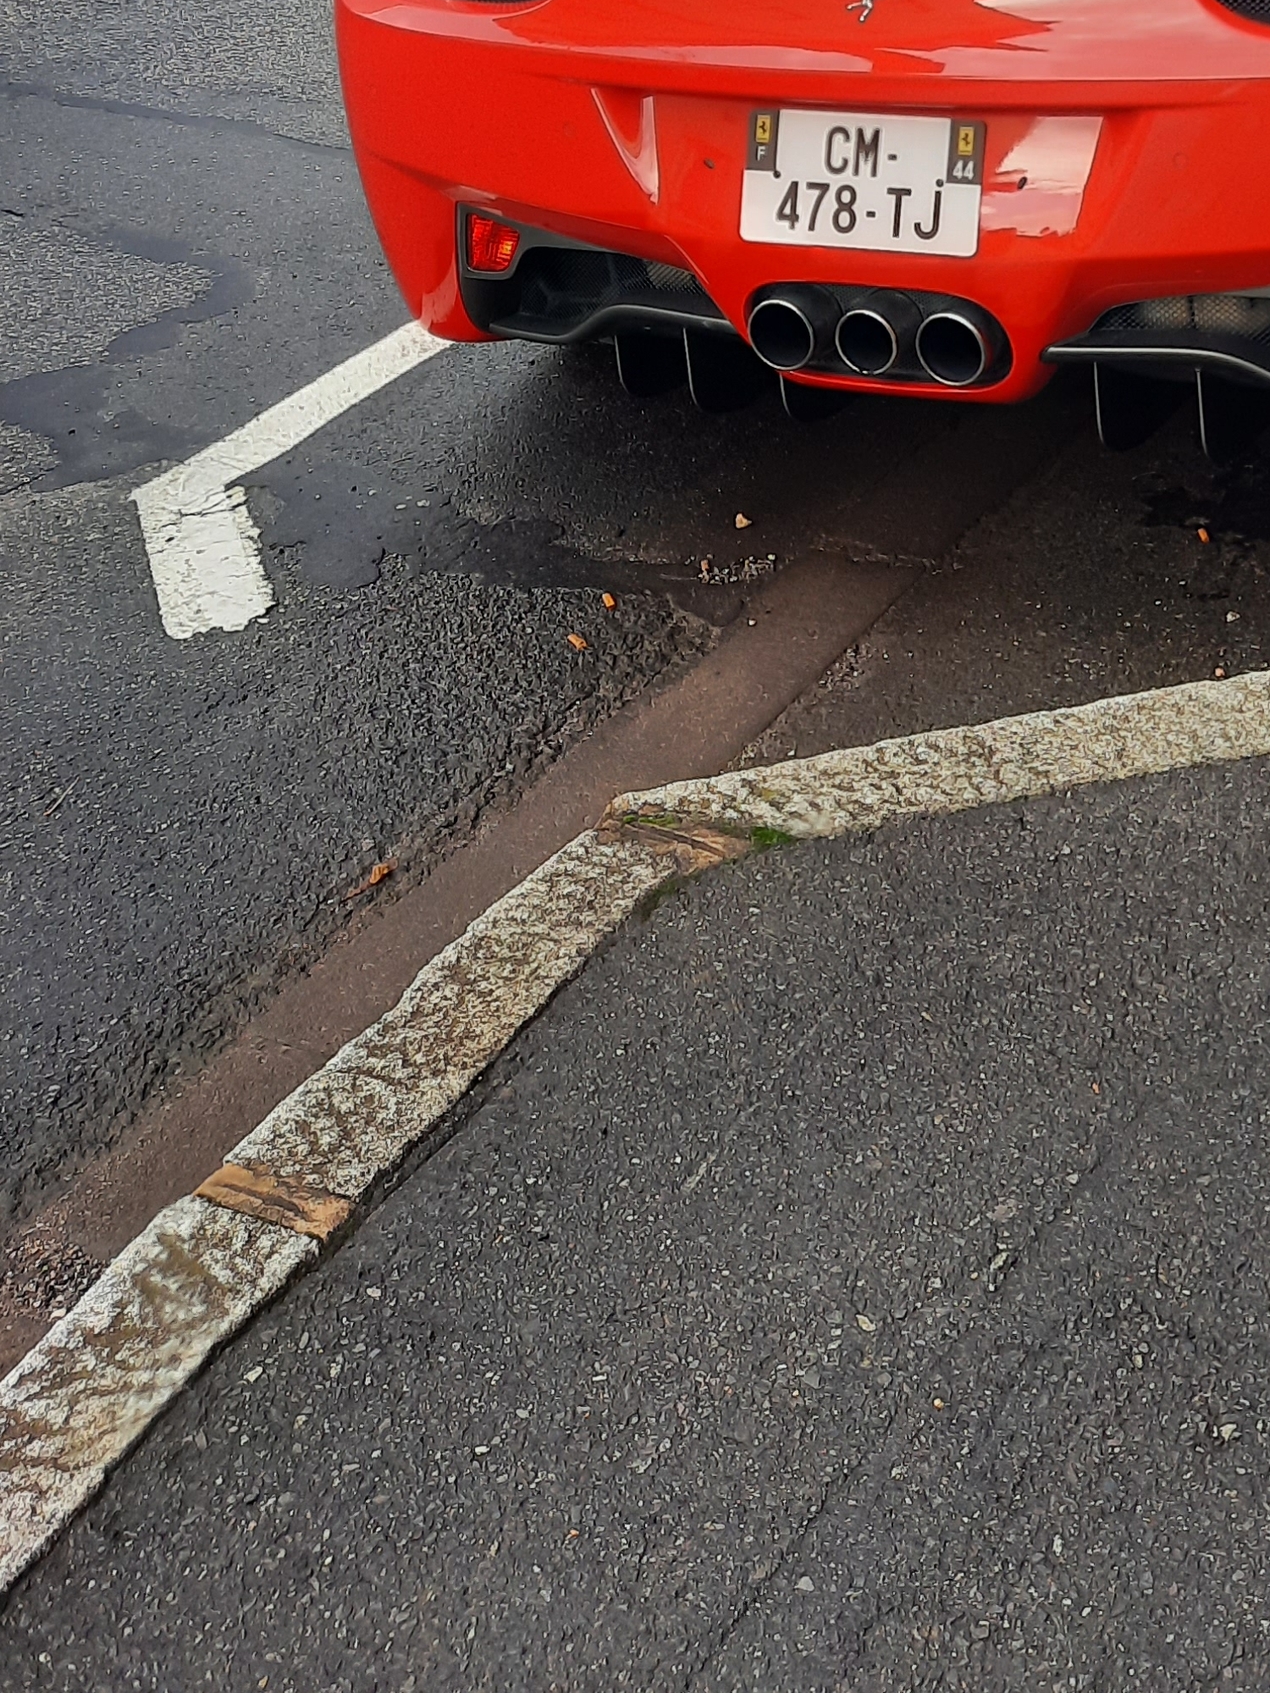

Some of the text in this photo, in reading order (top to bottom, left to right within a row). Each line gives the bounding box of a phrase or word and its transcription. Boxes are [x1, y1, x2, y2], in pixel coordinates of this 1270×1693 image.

[756, 146, 767, 161] F
[952, 160, 975, 180] 44
[776, 181, 942, 240] 478-TJ
